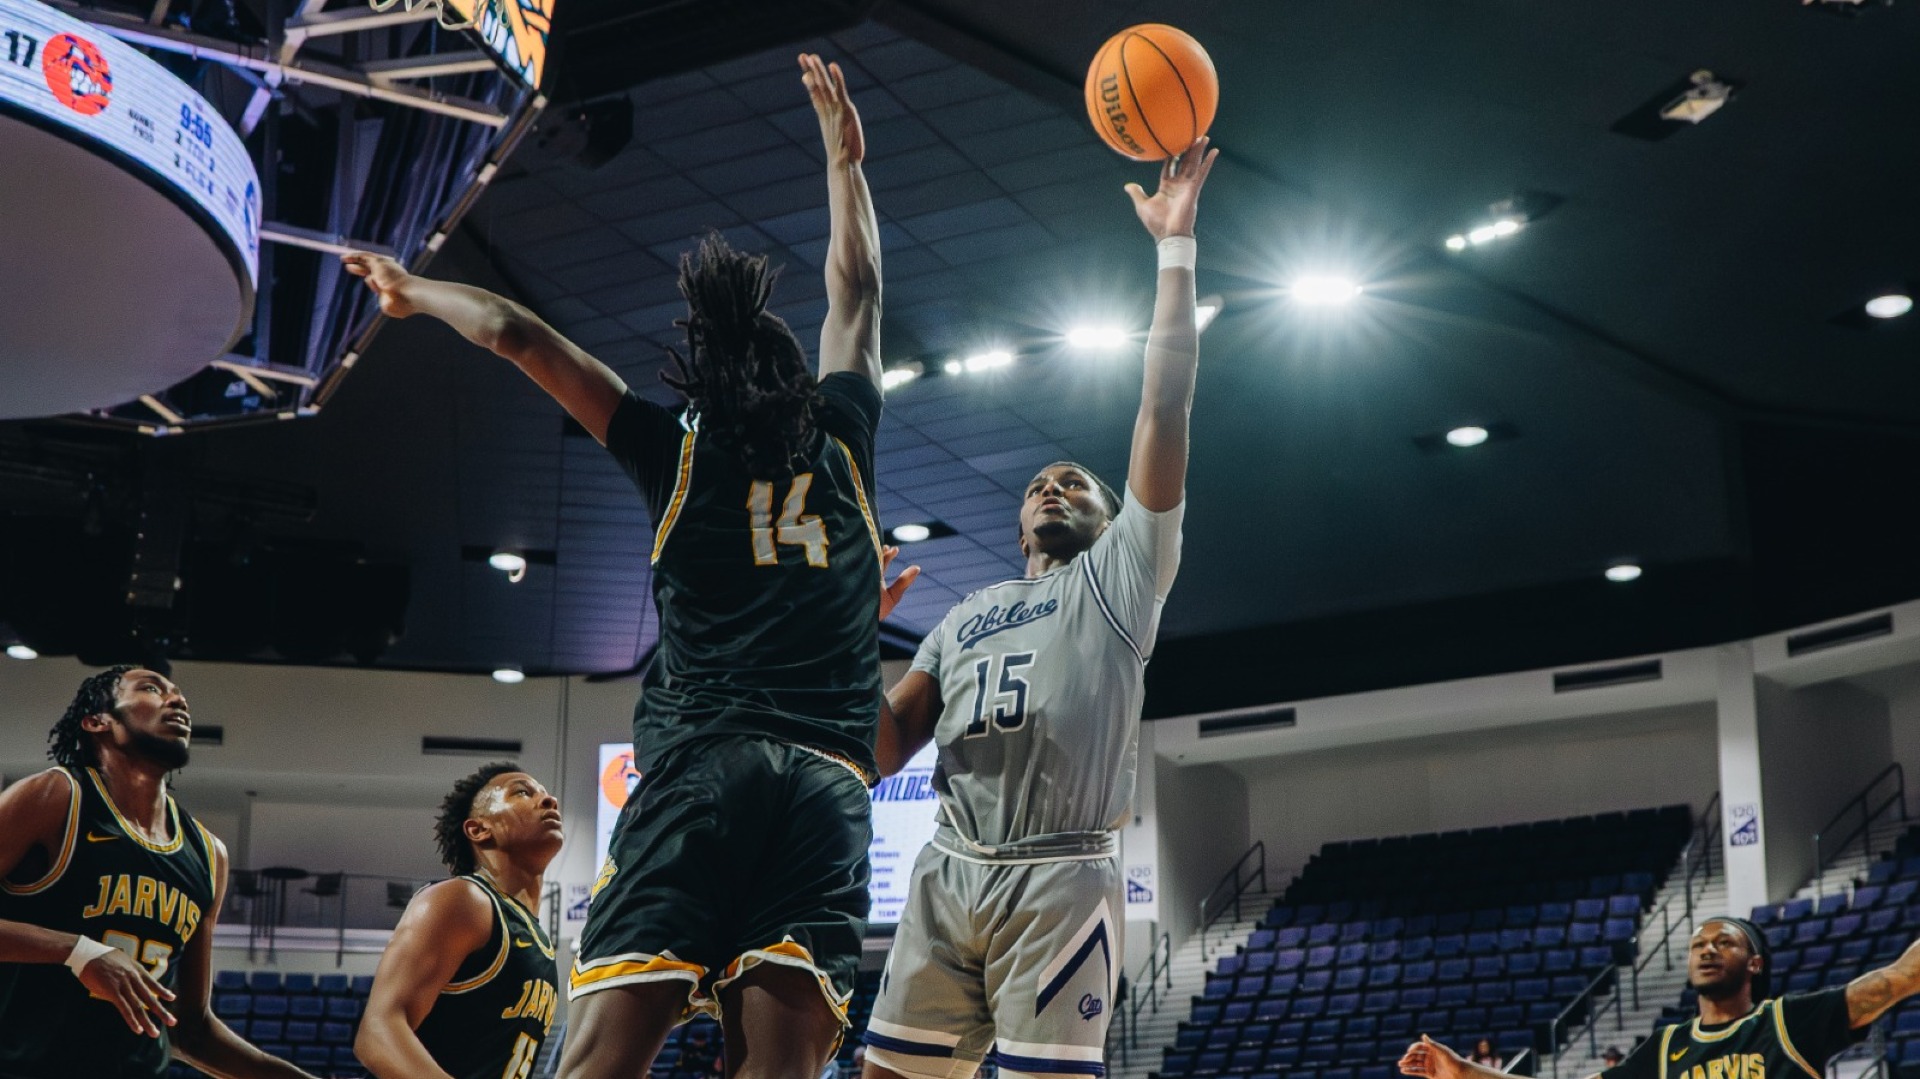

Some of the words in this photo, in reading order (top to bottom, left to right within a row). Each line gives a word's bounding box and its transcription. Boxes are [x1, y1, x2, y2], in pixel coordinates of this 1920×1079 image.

[5, 30, 38, 68] 17
[180, 103, 212, 149] 9:55
[1101, 73, 1146, 154] Wilson
[746, 472, 830, 568] 14
[957, 599, 1058, 650] Abilene
[964, 650, 1036, 739] 15
[82, 873, 201, 945] JARVIS
[502, 977, 558, 1036] JARV
